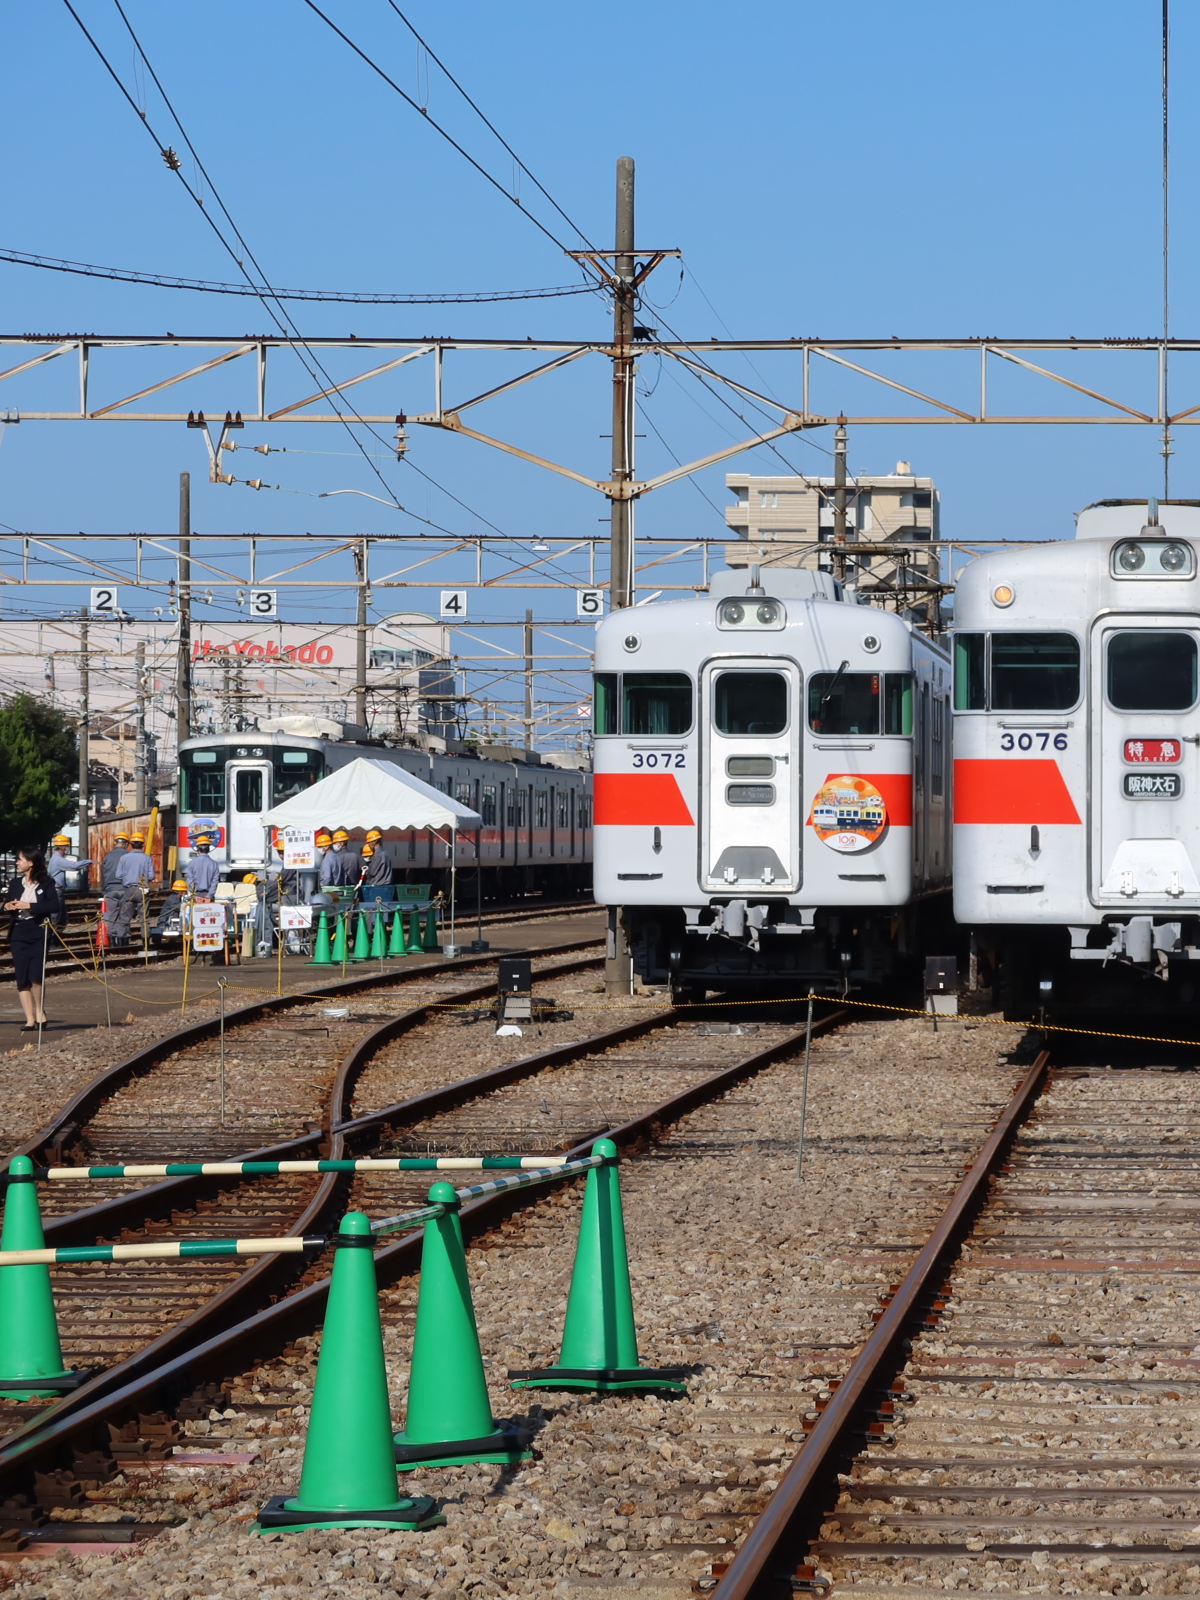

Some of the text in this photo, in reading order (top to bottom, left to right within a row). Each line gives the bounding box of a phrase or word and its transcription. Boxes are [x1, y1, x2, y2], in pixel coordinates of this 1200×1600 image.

[95, 590, 113, 611] 2
[255, 592, 273, 613] 3
[444, 593, 463, 614] 4
[581, 592, 599, 613] 5
[1000, 732, 1068, 751] 3076
[1128, 741, 1176, 757] 特急
[632, 753, 686, 768] 3072
[1128, 776, 1176, 792] 阪神大石
